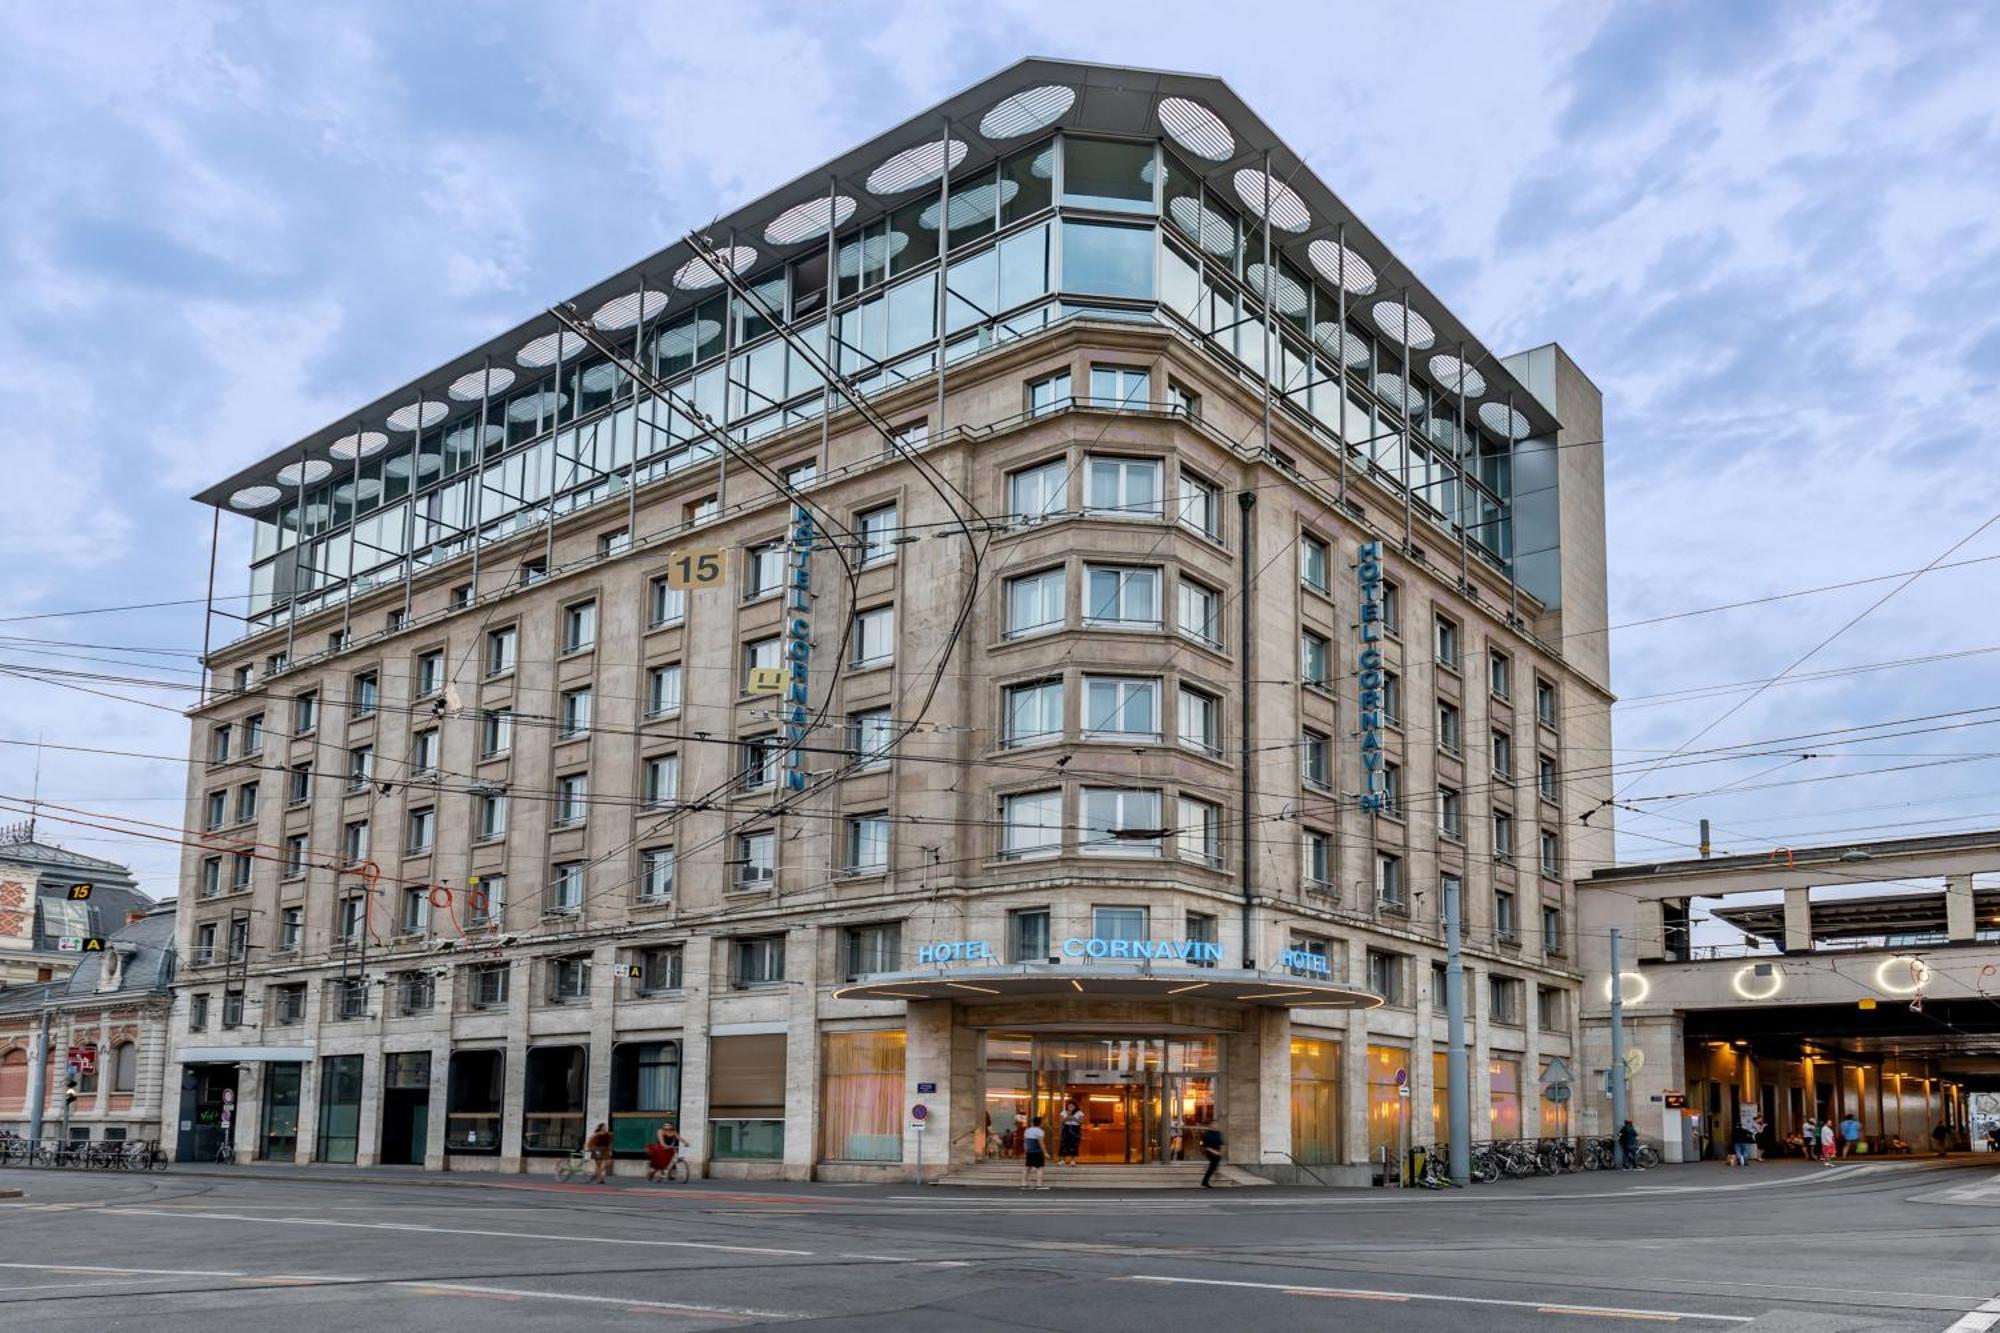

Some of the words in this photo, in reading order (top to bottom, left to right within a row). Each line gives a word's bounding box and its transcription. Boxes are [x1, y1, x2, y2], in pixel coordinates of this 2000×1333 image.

[676, 554, 719, 583] 15
[794, 506, 813, 613] HOTEL
[1359, 541, 1380, 642] HOTEL
[789, 617, 810, 792] CORNAVIN
[1359, 647, 1382, 813] CORNAVIN
[73, 884, 90, 898] 15
[86, 939, 101, 950] A
[918, 940, 992, 964] HOTEL
[1062, 936, 1225, 961] CORNAVIN
[630, 967, 640, 977] A
[1280, 949, 1331, 974] HOTEL
